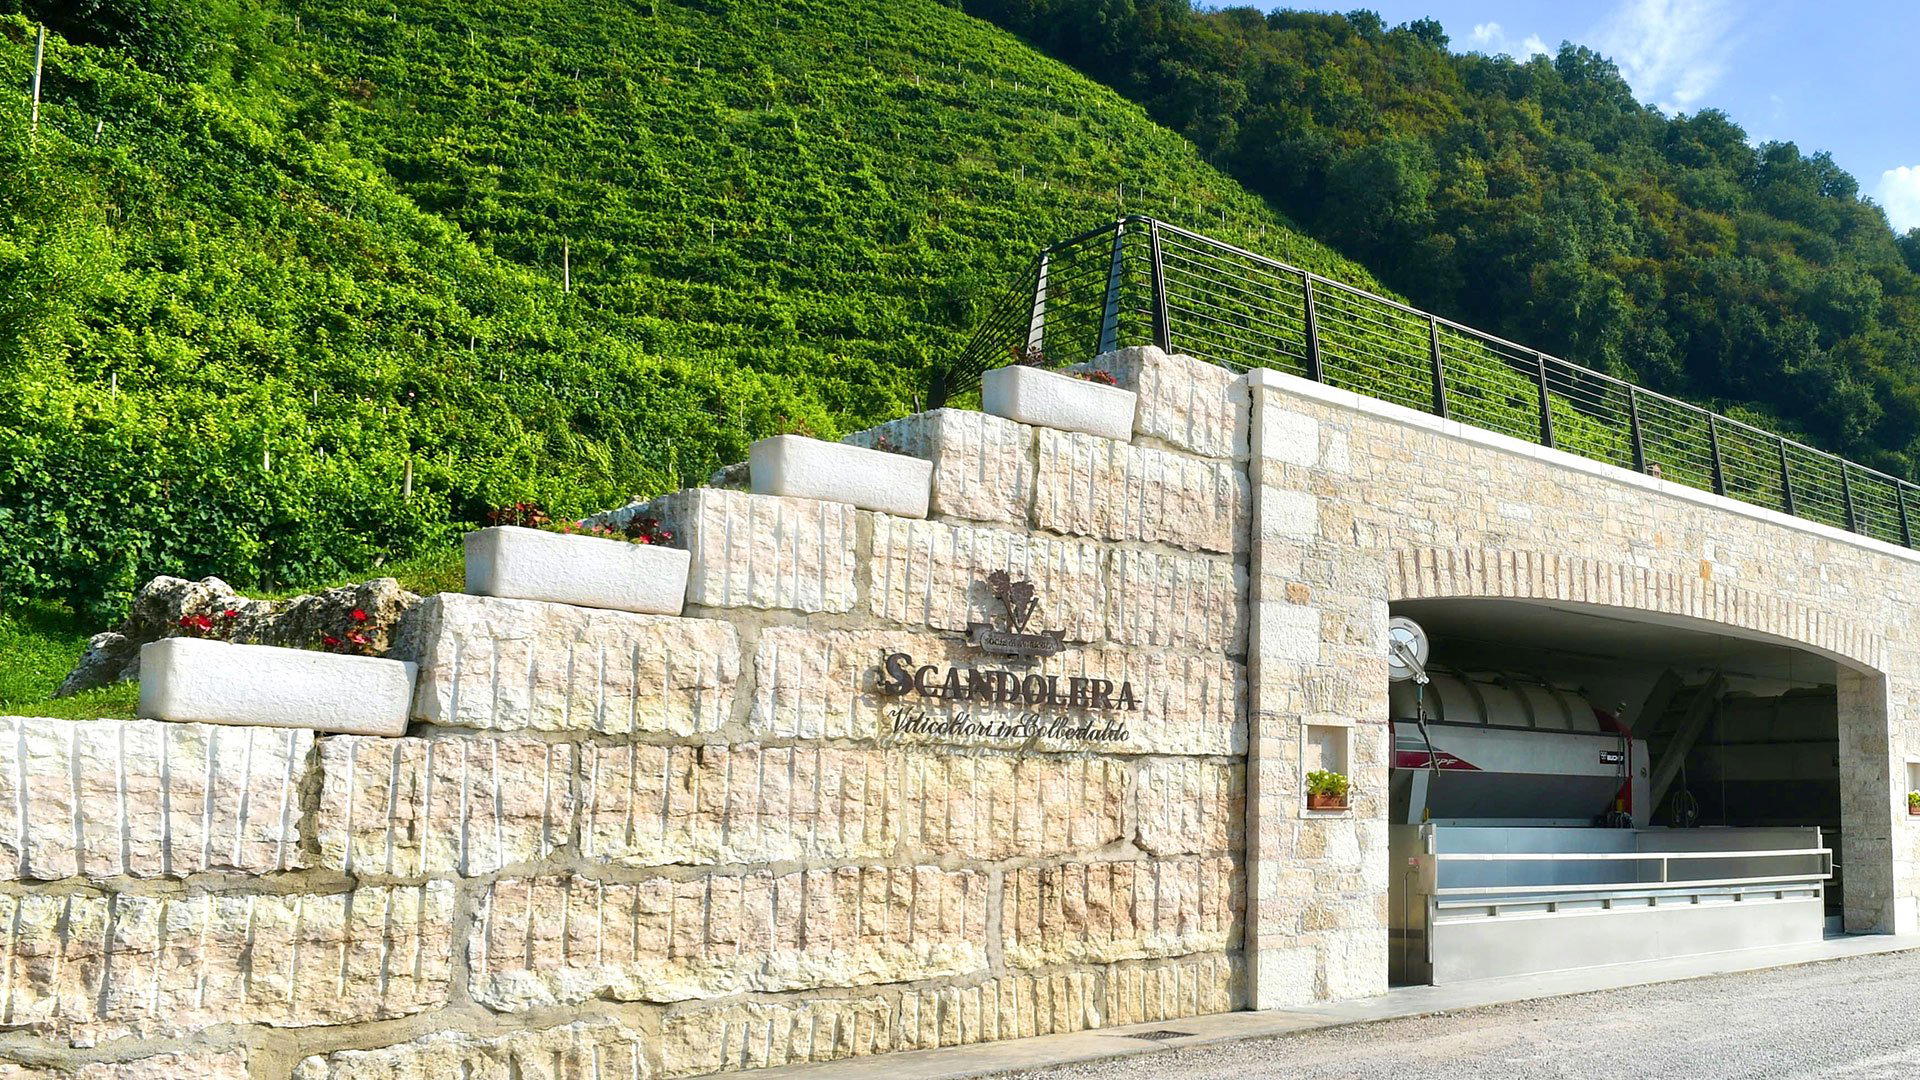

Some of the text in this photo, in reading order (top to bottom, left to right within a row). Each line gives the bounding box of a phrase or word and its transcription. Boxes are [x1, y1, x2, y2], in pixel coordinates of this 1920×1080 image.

[885, 653, 1138, 711] SCANDOLERA
[888, 706, 1130, 742] Viticoltori in Colbertaldo
